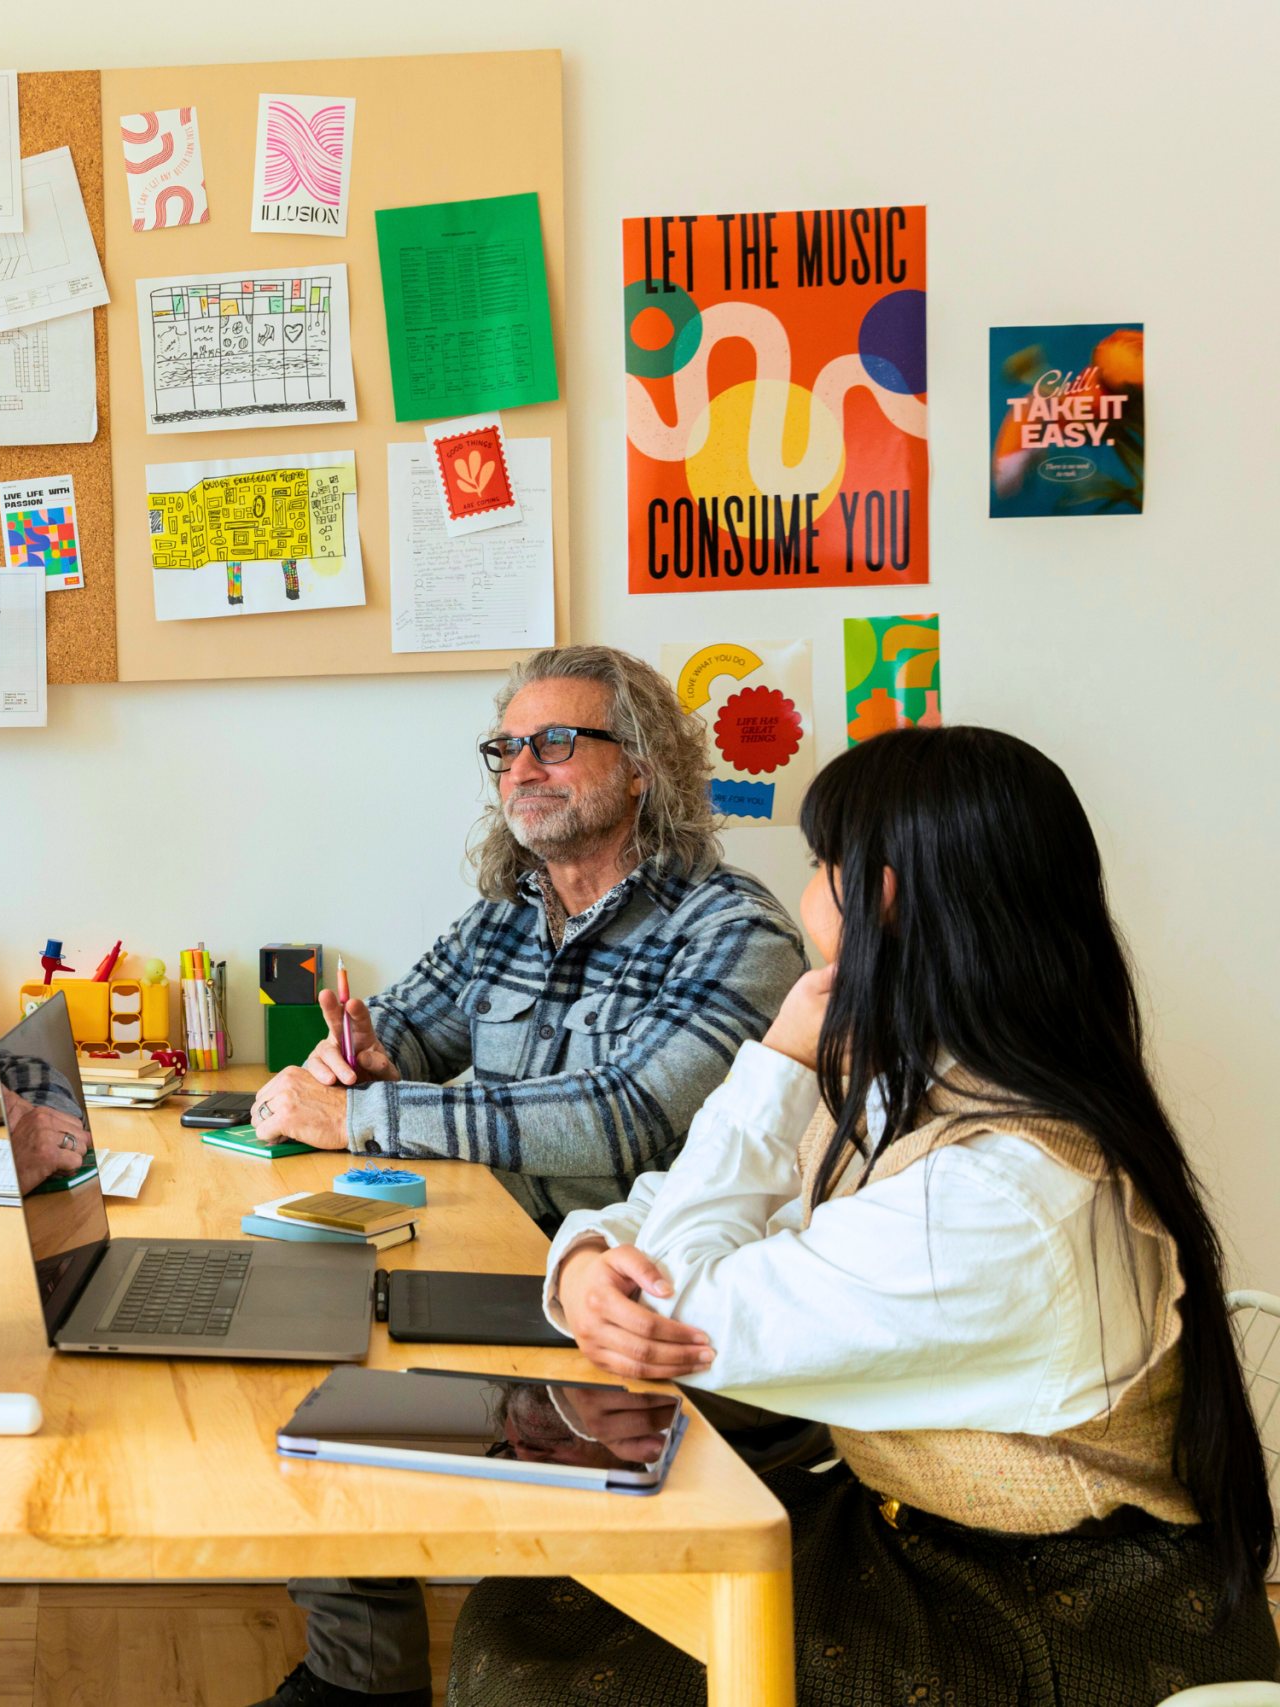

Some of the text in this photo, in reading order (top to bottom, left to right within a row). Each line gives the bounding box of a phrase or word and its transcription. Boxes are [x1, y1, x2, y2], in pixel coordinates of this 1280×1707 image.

[184, 126, 195, 140] THIS
[184, 142, 195, 157] THAN
[173, 158, 190, 176] BETTER
[148, 177, 161, 190] GET
[160, 172, 172, 183] ANY
[138, 187, 152, 206] CAN'T
[261, 204, 340, 225] ILLUSION
[644, 206, 907, 294] LET THE MUSIC
[1033, 366, 1101, 401] Chill.
[1007, 395, 1129, 422] TAKE IT
[1021, 422, 1115, 448] EASY.
[446, 439, 493, 459] GOOD THINGS
[3, 487, 70, 501] LIVE LIFE WITH
[4, 498, 43, 509] PASSION
[463, 496, 500, 511] ARE COMING
[648, 493, 820, 580] CONSUME
[840, 489, 911, 573] YOU
[687, 654, 746, 699] LOVE WHAT YOU DO.
[736, 716, 779, 726] LIFE HAS
[741, 725, 775, 735] GREAT
[740, 734, 776, 743] THINGS
[728, 795, 745, 803] FOR
[747, 796, 765, 805] YOU.
